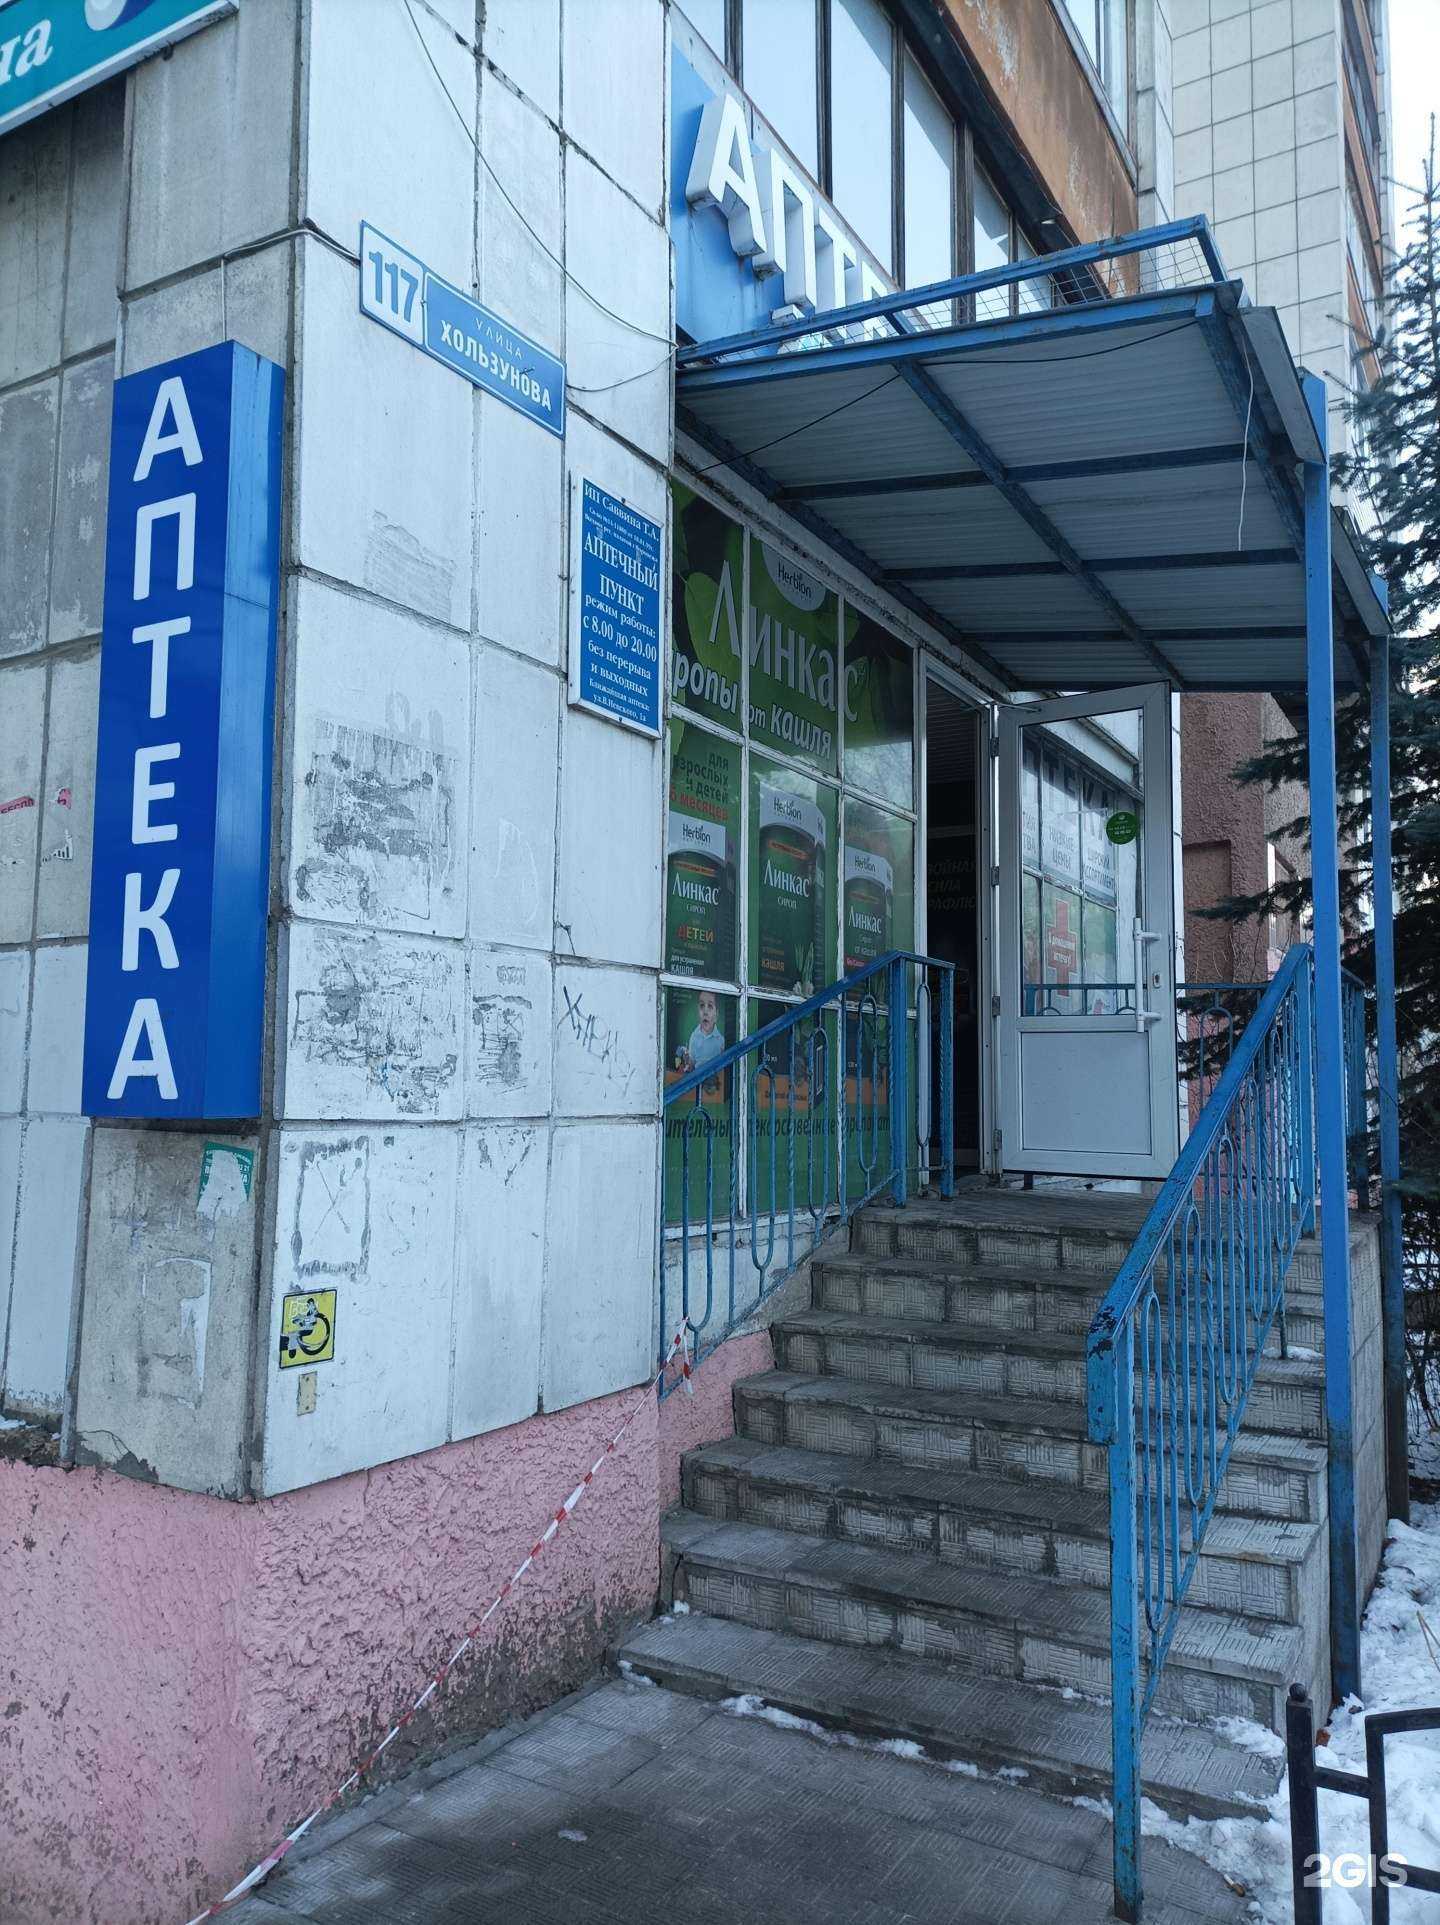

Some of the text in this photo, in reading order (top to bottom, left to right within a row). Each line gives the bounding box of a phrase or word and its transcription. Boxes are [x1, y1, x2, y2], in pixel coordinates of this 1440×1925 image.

[368, 250, 419, 324] 117
[475, 318, 524, 359] УЛИЦА
[440, 319, 552, 412] ХОЛЬЗУНОВА
[585, 484, 600, 504] ИП
[584, 532, 658, 592] АПТЕЧНЫЙ
[777, 560, 812, 599] Herbion
[600, 574, 644, 615] ПУНКТ
[585, 594, 656, 639] режим работы:
[583, 615, 657, 663] с 8.00 до 20.00
[588, 640, 652, 680] без перерыва
[600, 667, 648, 697] выходных
[673, 650, 738, 714] ропы
[769, 703, 832, 755] кашля
[106, 375, 204, 1101] АПТЕКА
[708, 752, 729, 771] для
[773, 796, 803, 821] Herbion
[682, 823, 711, 844] Herbion
[672, 873, 720, 906] Линкас
[763, 859, 811, 898] Линкас
[848, 906, 883, 935] Линкас
